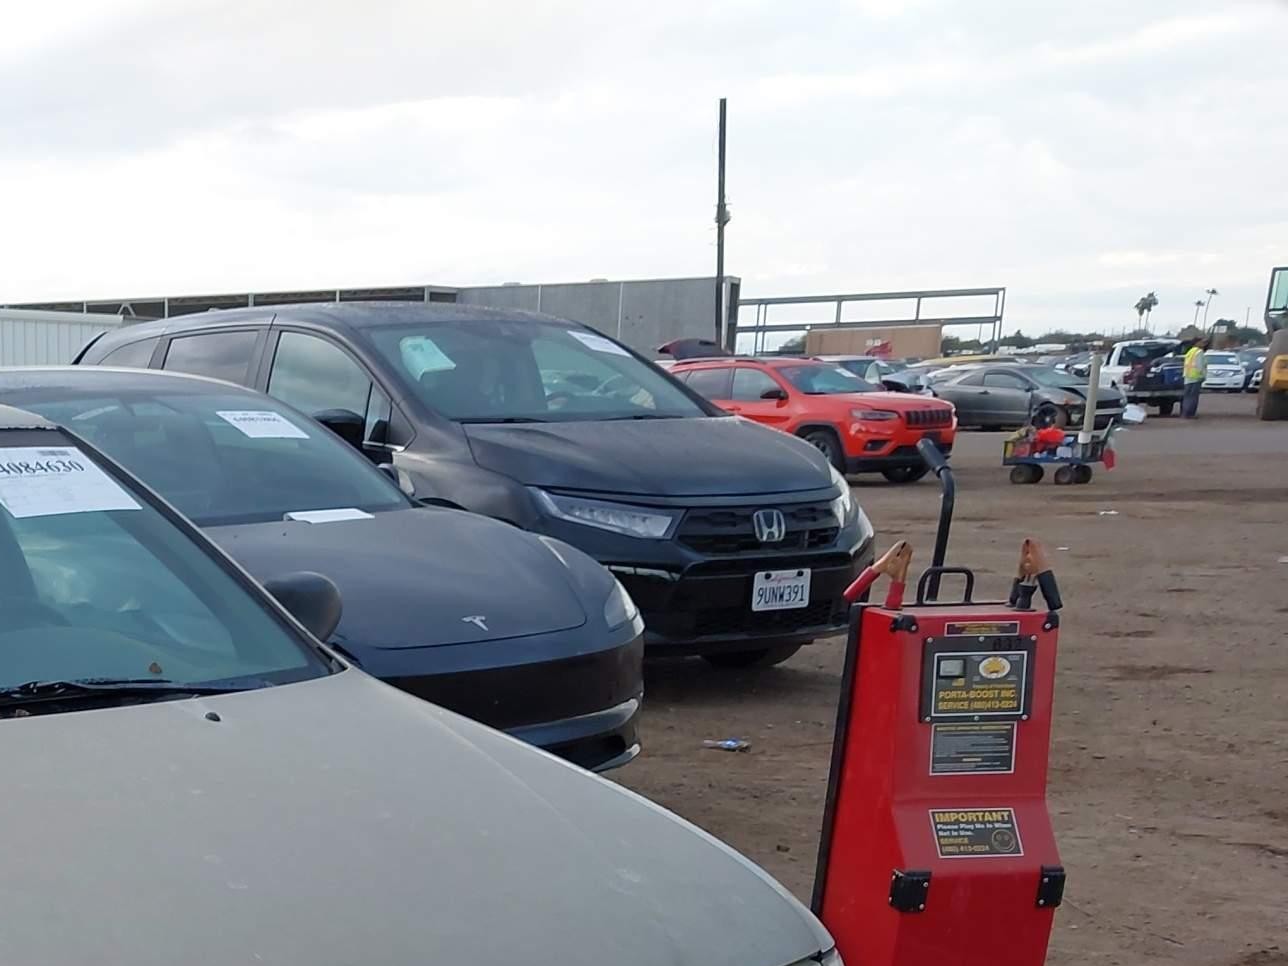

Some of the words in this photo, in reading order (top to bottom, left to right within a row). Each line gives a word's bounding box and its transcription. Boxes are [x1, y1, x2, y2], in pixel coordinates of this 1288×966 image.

[757, 584, 804, 605] 9UNW391
[938, 690, 999, 699] PORTA-BOOST
[935, 811, 1010, 822] IMPORTANT
